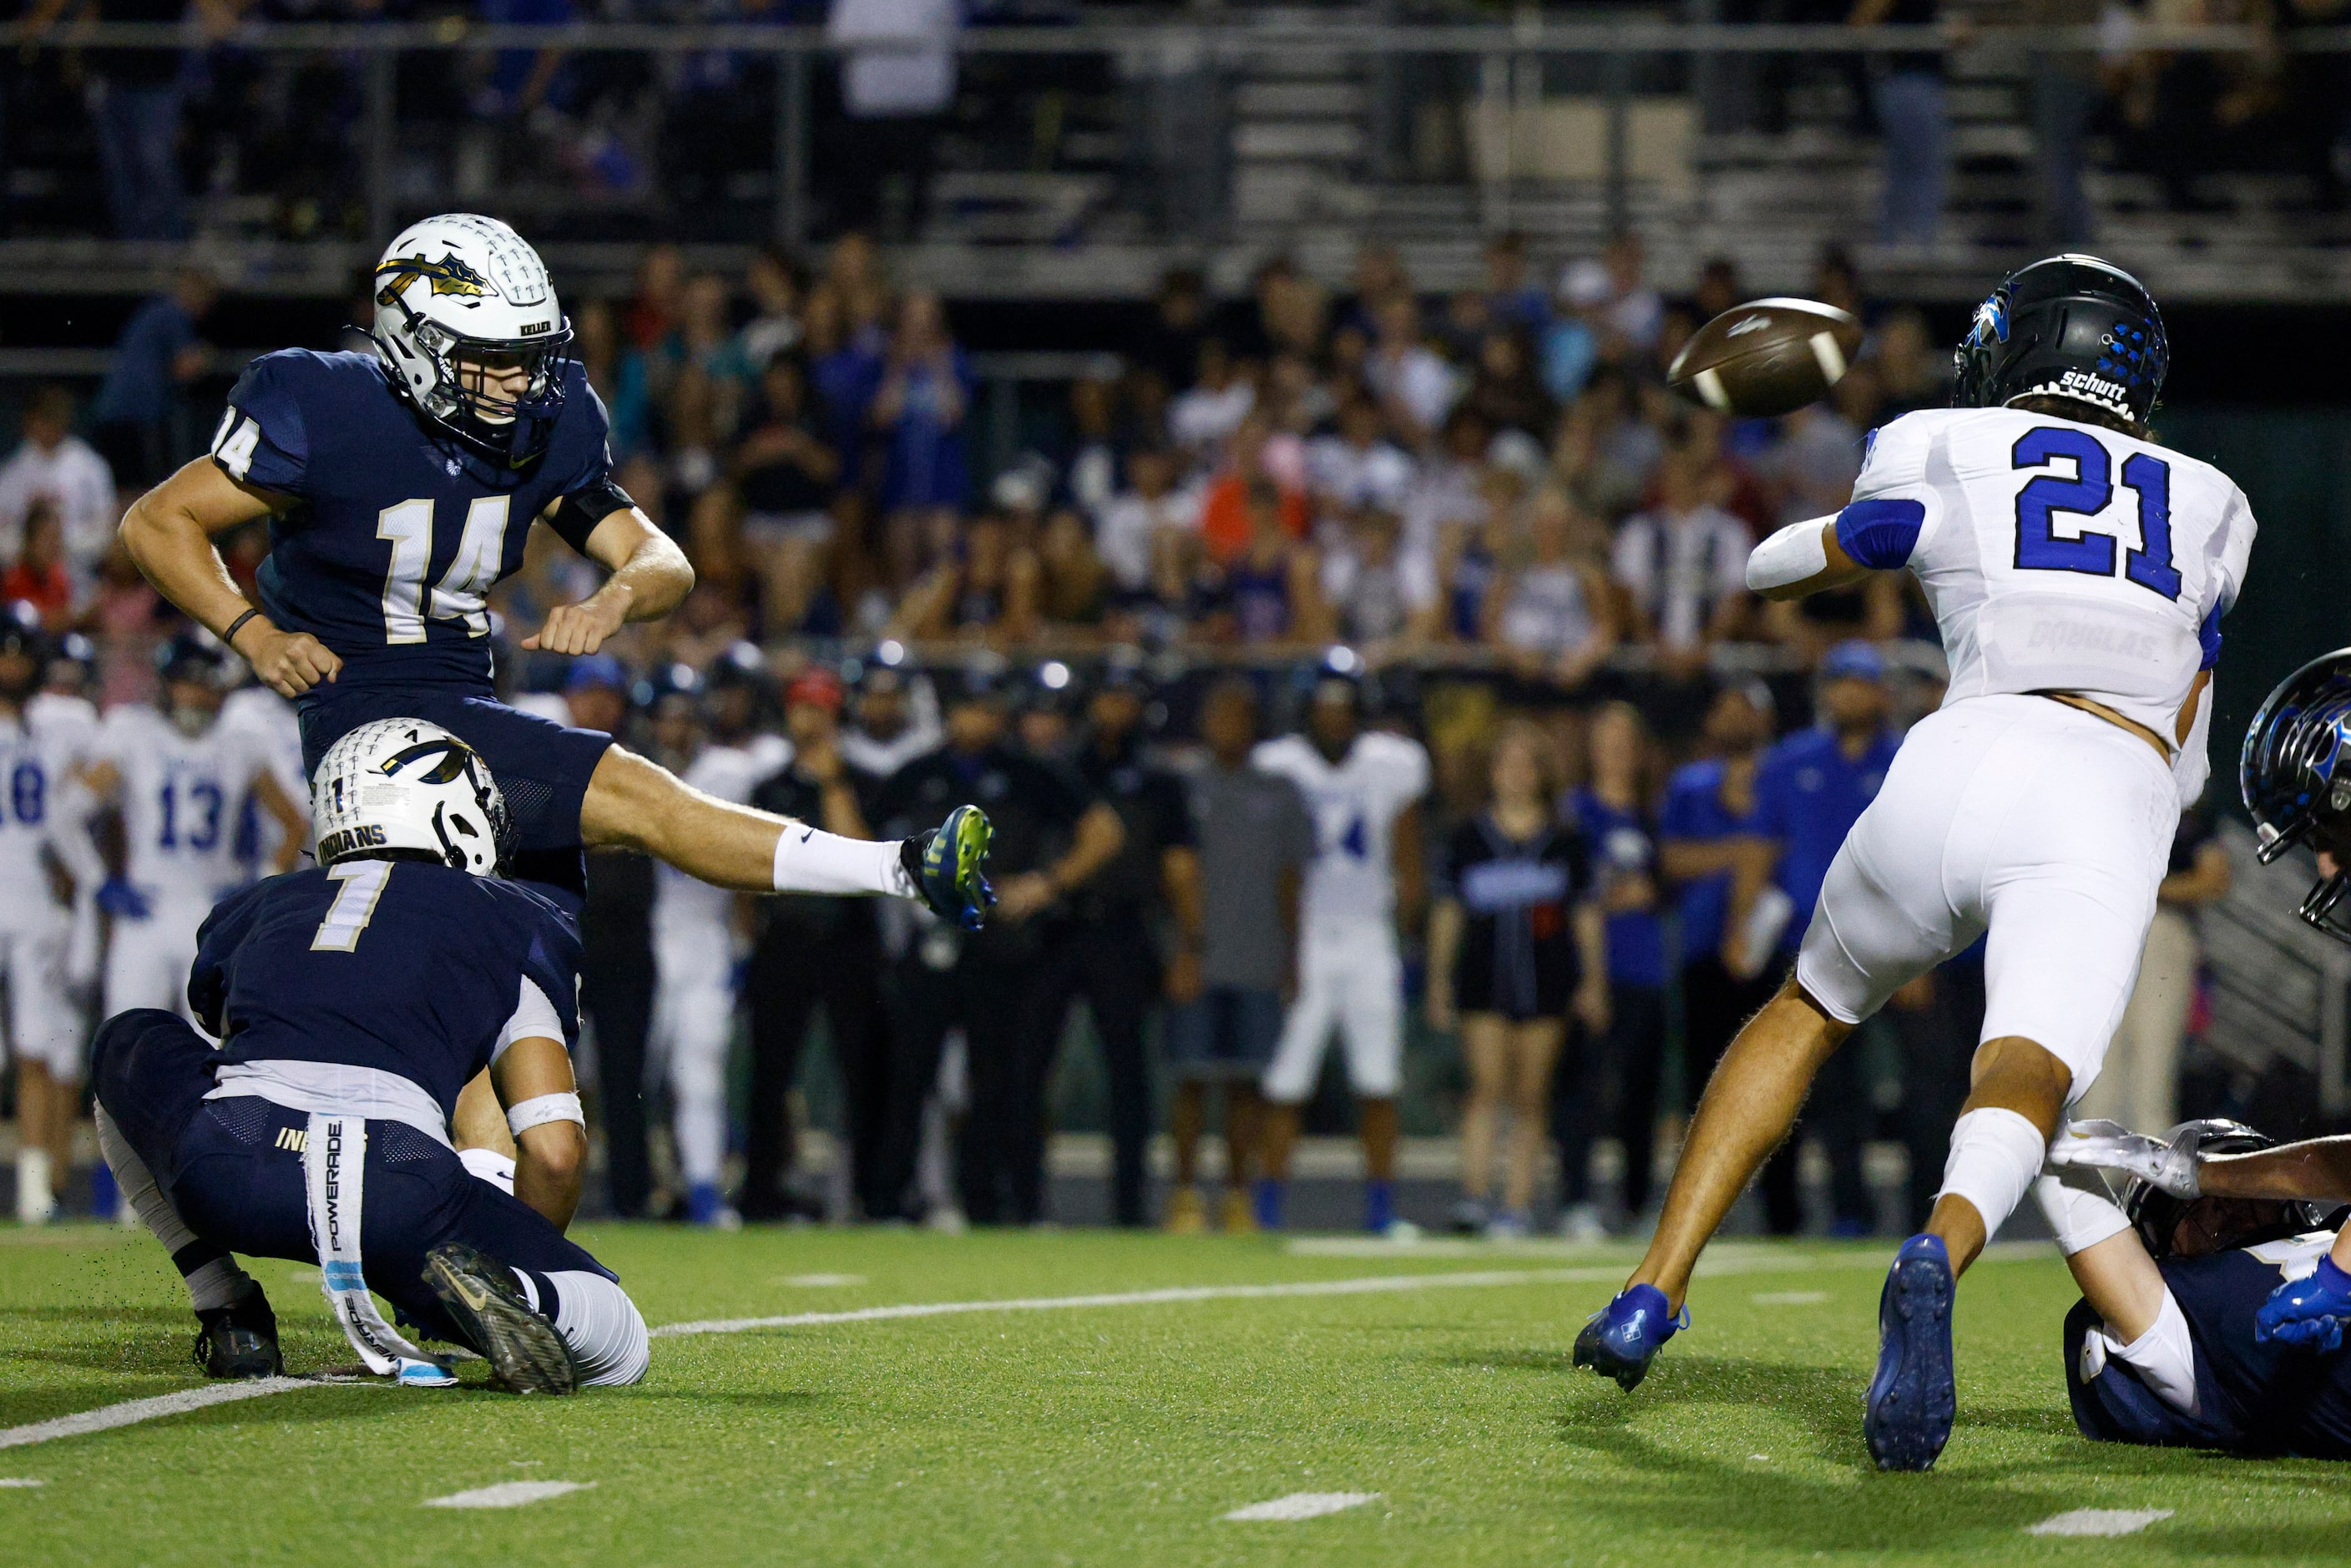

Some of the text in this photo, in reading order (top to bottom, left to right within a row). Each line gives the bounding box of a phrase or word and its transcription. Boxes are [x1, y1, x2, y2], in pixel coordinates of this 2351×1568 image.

[520, 321, 551, 336] KELLER
[2060, 371, 2126, 402] schutt
[211, 405, 260, 483] 14
[2012, 426, 2182, 603] 21
[376, 494, 511, 645] 14
[2027, 620, 2156, 659] DOUGLAS
[161, 781, 222, 852] 13
[331, 776, 344, 814] 1
[317, 823, 388, 866] INDIANS
